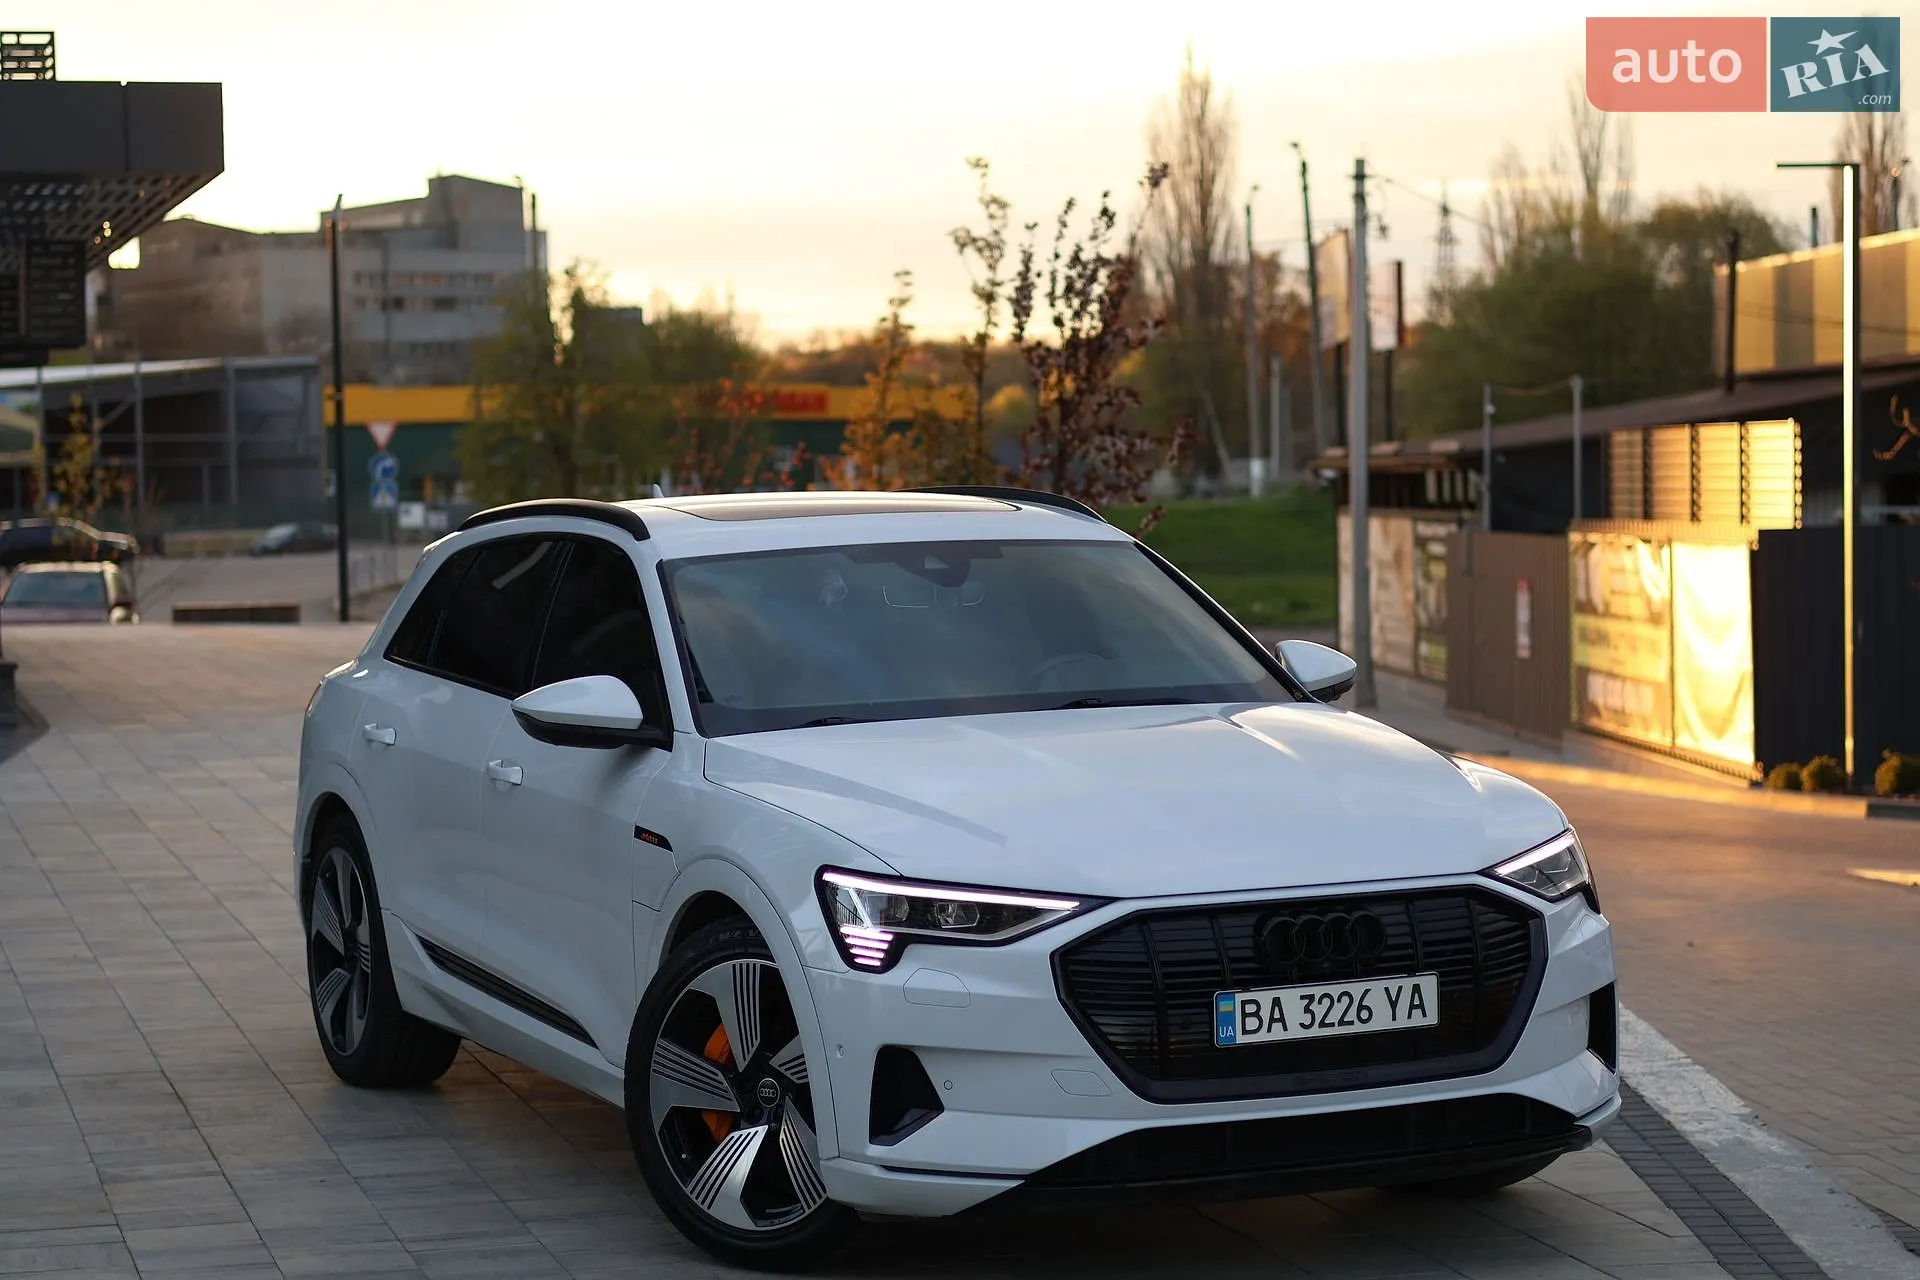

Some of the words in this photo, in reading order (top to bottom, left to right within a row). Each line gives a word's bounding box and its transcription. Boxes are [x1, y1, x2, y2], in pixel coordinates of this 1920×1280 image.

[1240, 996, 1289, 1036] BA
[1298, 988, 1374, 1030] 3226
[1383, 983, 1428, 1022] YA
[1219, 1027, 1234, 1038] UA
